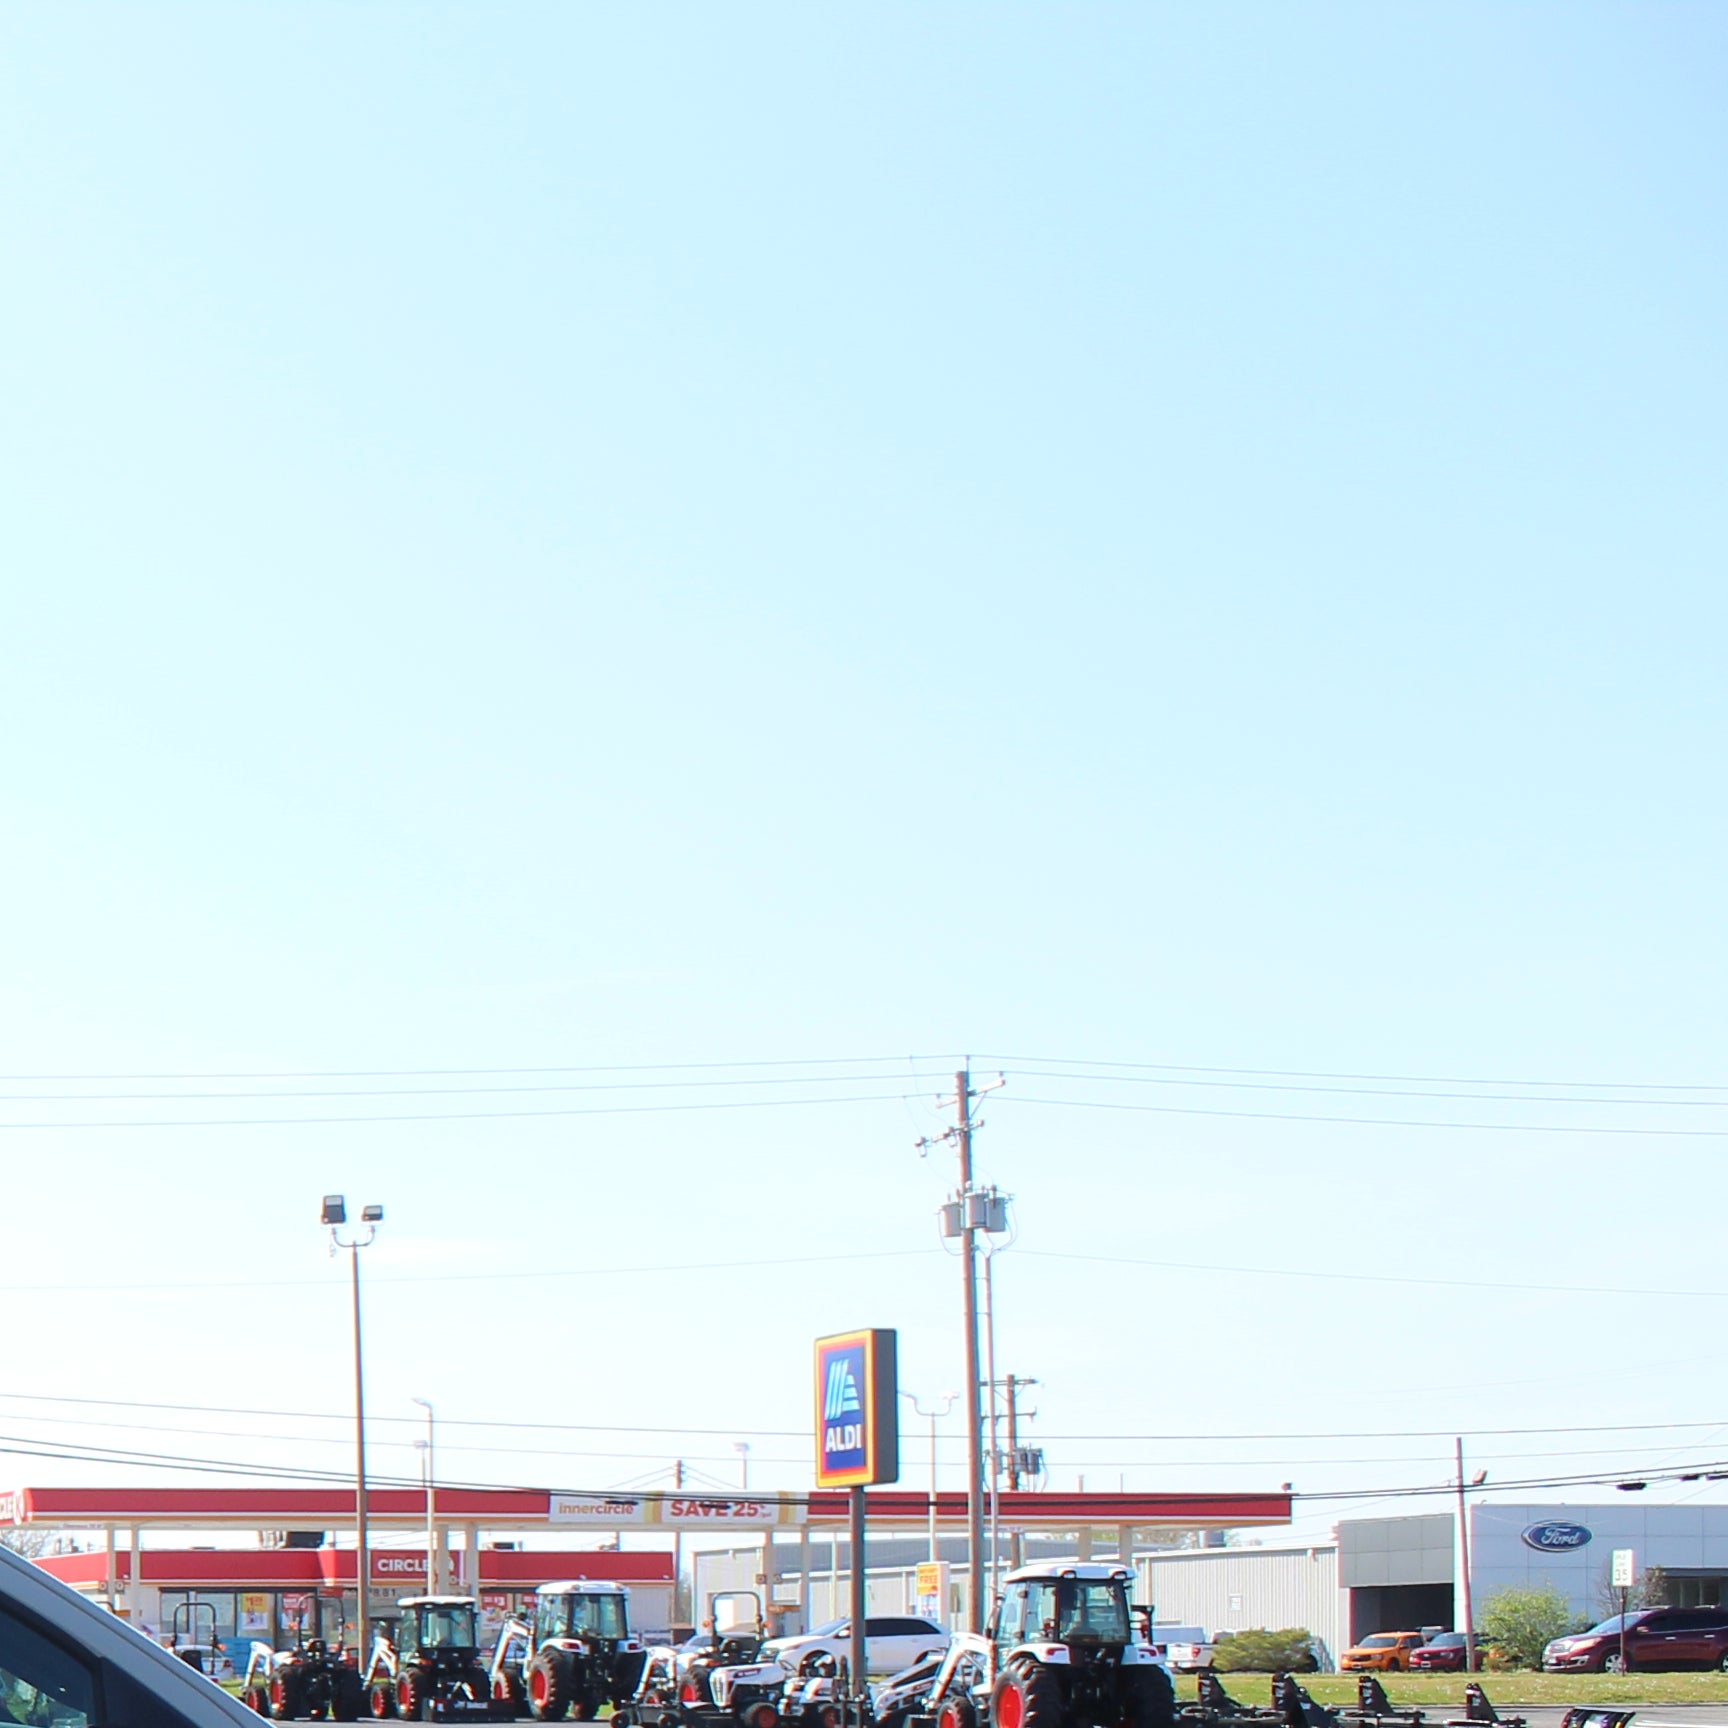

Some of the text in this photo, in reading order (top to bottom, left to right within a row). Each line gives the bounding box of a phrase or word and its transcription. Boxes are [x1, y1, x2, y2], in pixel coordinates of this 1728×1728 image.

[825, 1423, 862, 1453] ALDI
[670, 1501, 728, 1517] SAVE
[1541, 1527, 1580, 1545] Ford
